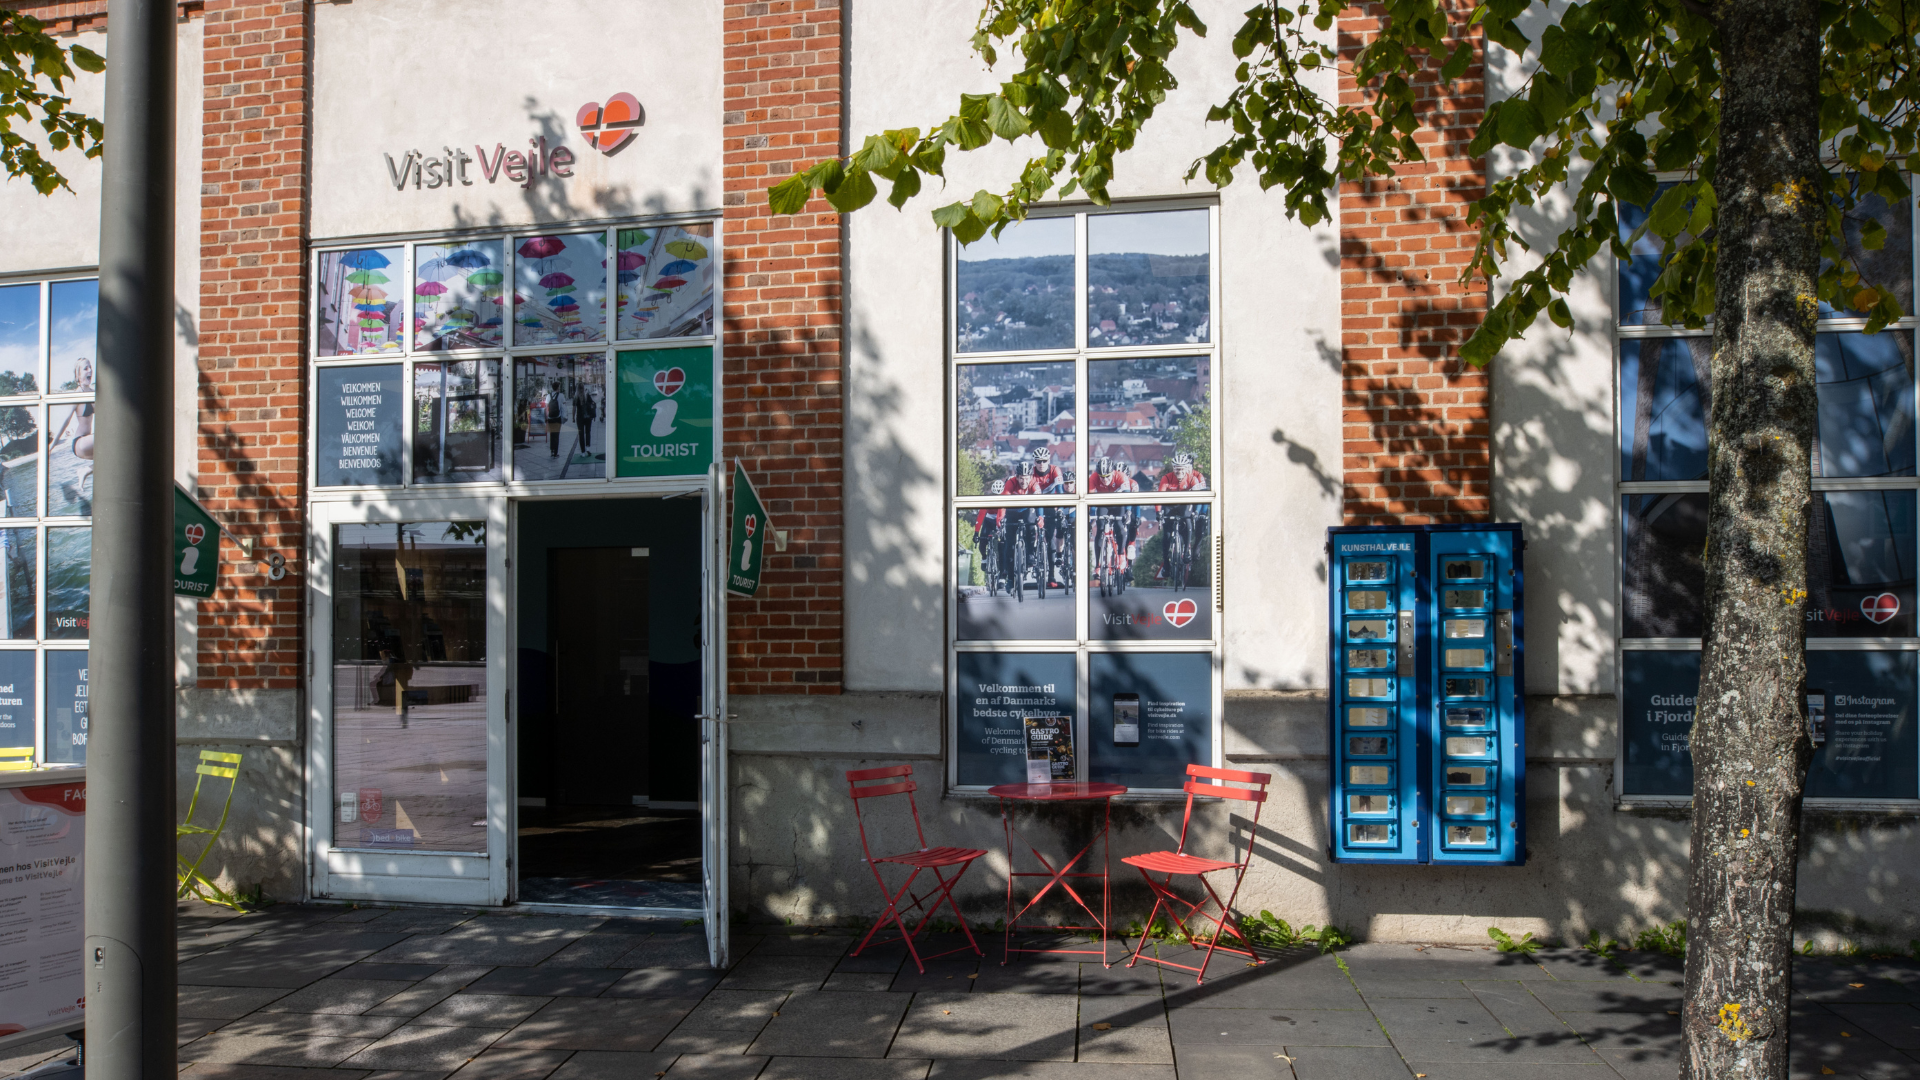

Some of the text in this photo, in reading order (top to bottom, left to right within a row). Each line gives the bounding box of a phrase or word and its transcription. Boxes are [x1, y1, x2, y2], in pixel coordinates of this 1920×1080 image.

[342, 383, 381, 393] VELKOMMEN
[341, 395, 382, 406] WILLKOMMEN
[345, 408, 376, 418] WELCOME
[347, 420, 375, 431] WELKOM
[341, 432, 380, 444] VÄLKOMMEN
[343, 446, 378, 456] BIENVENUE
[631, 443, 699, 457] TOURIST
[339, 458, 382, 469] BIENVENIDOS
[1341, 543, 1411, 552] KUNSTHAL VEJLE
[268, 552, 286, 581] 8
[732, 574, 756, 590] TOURIST
[979, 684, 1055, 693] Velkommen til
[991, 696, 1001, 705] af
[1003, 697, 1056, 705] Danmarks
[1846, 695, 1896, 709] Instagram
[973, 708, 1007, 717] bedste
[1646, 710, 1652, 721] i
[990, 747, 1018, 755] cycling
[1661, 743, 1670, 751] in
[16, 863, 32, 871] hos
[34, 856, 76, 868] VisitVejle
